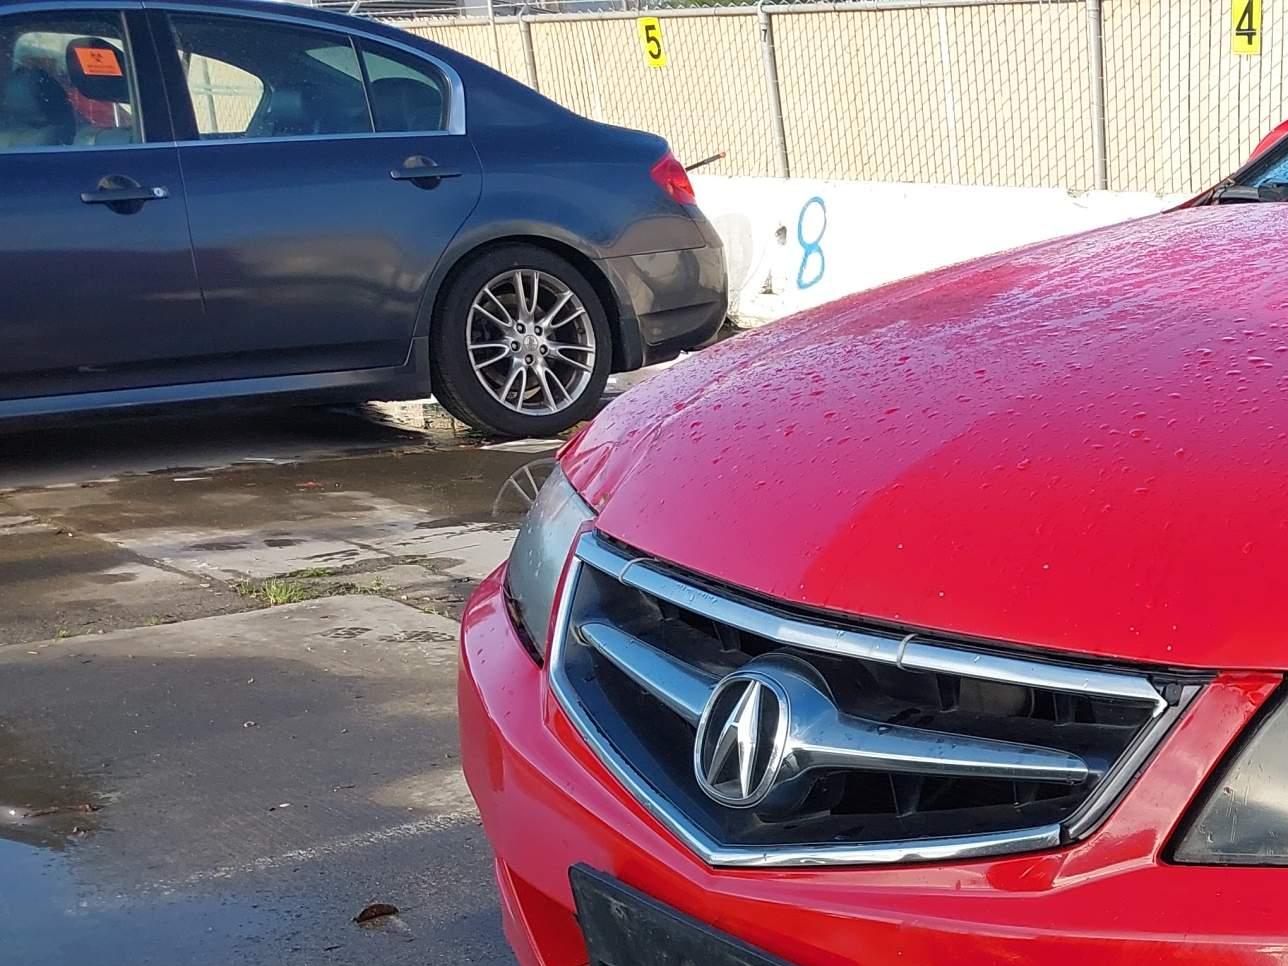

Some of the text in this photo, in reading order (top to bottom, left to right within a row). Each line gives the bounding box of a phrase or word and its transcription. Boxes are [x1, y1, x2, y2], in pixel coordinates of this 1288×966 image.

[644, 24, 662, 60] 5
[1235, 0, 1257, 46] 4
[796, 196, 828, 290] 8
